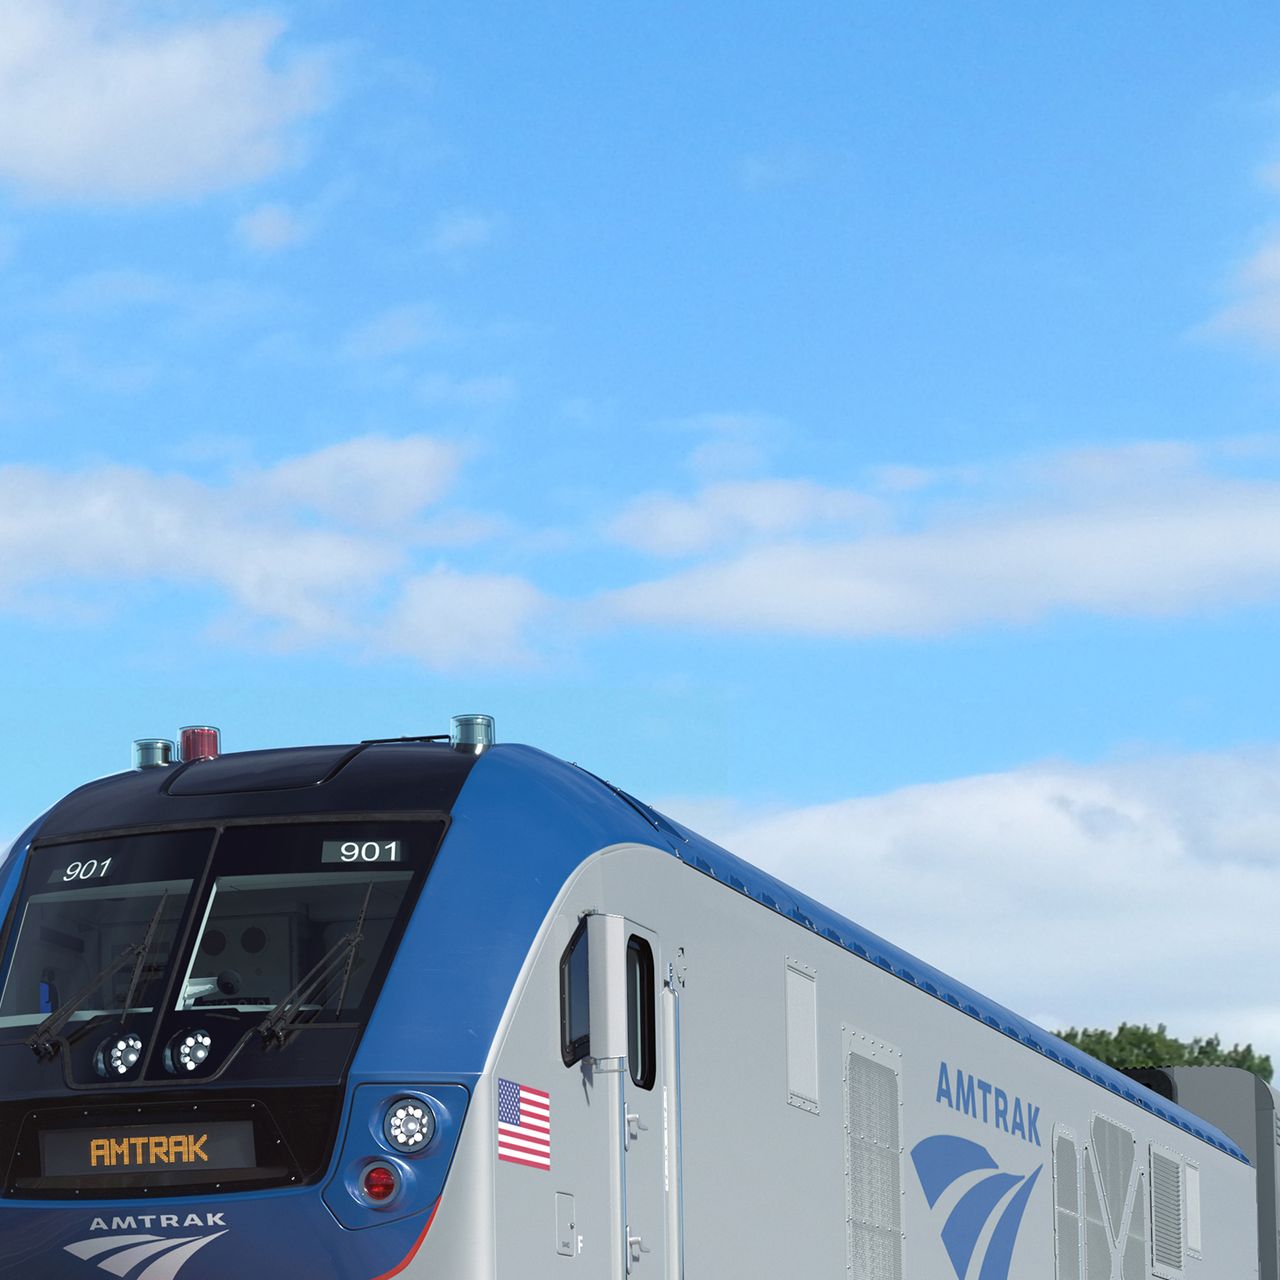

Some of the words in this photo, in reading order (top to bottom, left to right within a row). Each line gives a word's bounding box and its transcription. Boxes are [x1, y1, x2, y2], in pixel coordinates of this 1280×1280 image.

[340, 841, 397, 862] 901
[63, 857, 113, 882] 901
[936, 1061, 1041, 1147] AMTRAK
[90, 1134, 208, 1167] AMTRAK
[89, 1212, 227, 1231] AMTRAK
[577, 1235, 583, 1254] F
